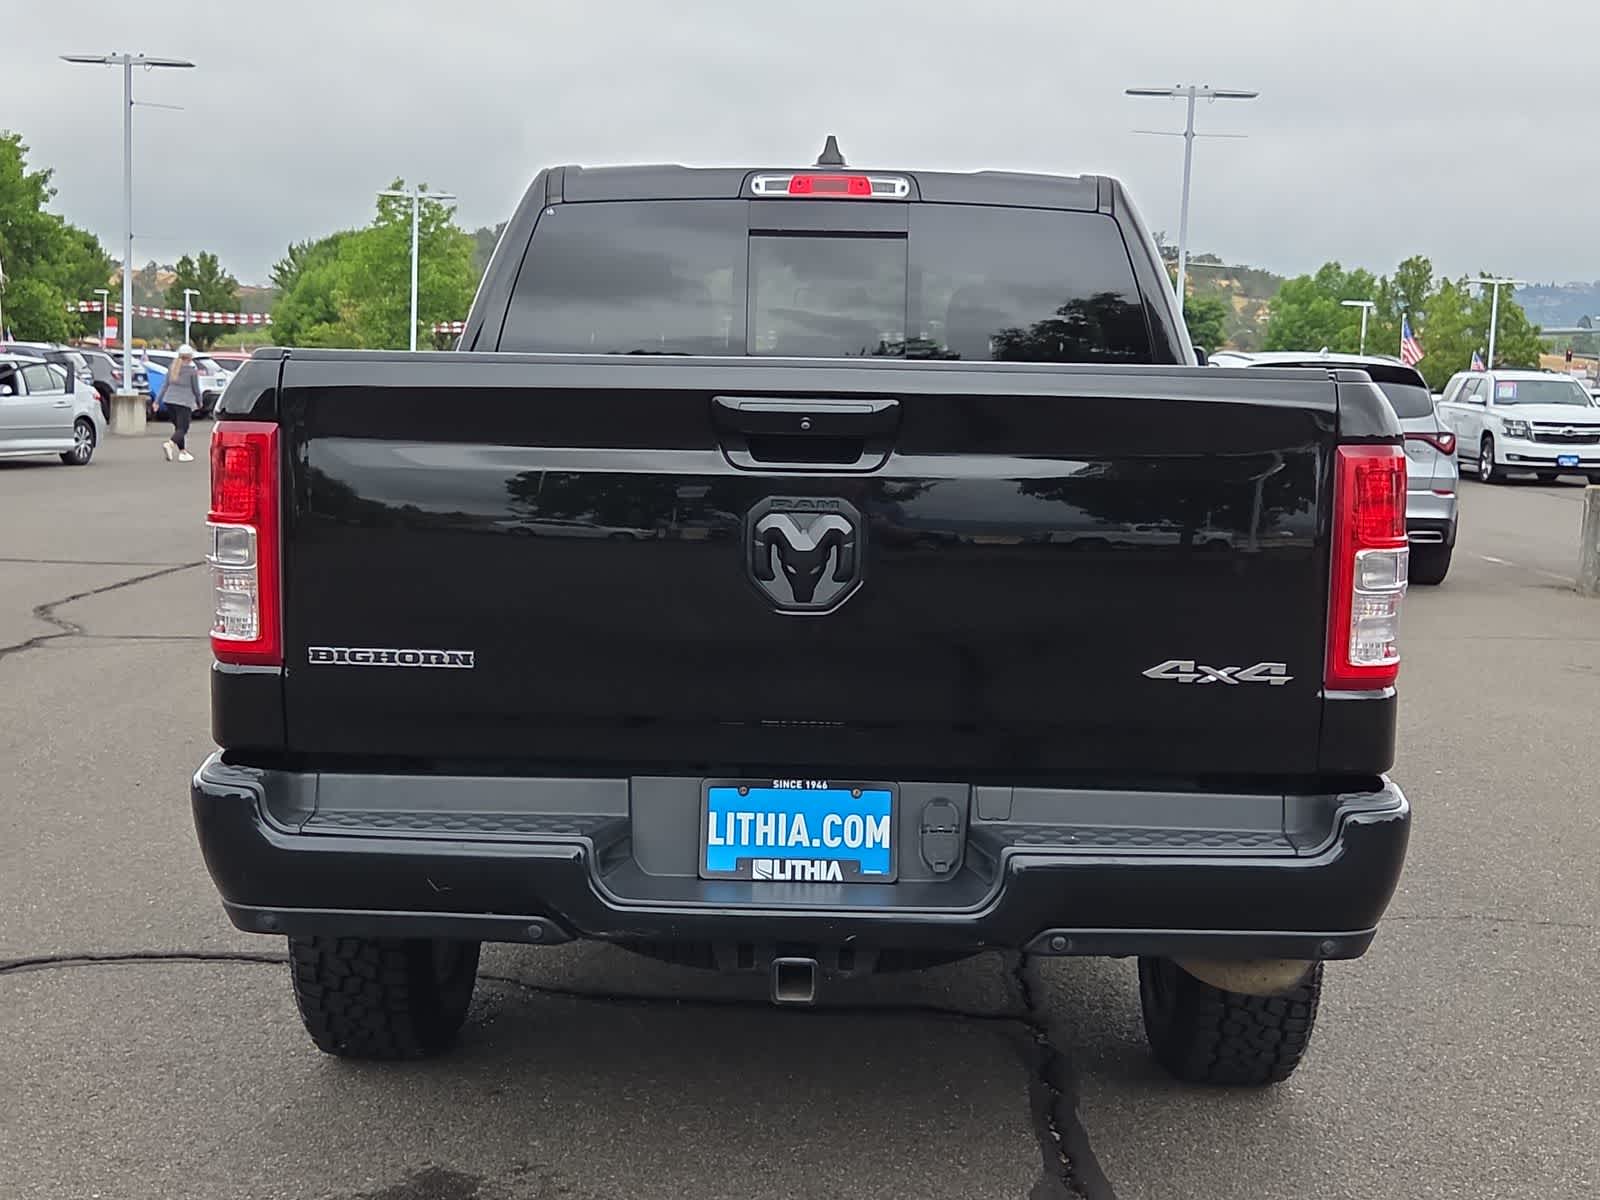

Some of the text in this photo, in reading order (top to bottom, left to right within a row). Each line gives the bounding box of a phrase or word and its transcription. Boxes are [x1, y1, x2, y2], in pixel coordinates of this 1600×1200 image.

[770, 499, 840, 511] RAM
[308, 647, 474, 668] BIGHORN
[772, 779, 828, 790] SINCE 1946
[708, 811, 890, 849] LITHIA.COM
[773, 859, 843, 881] LITHIA
